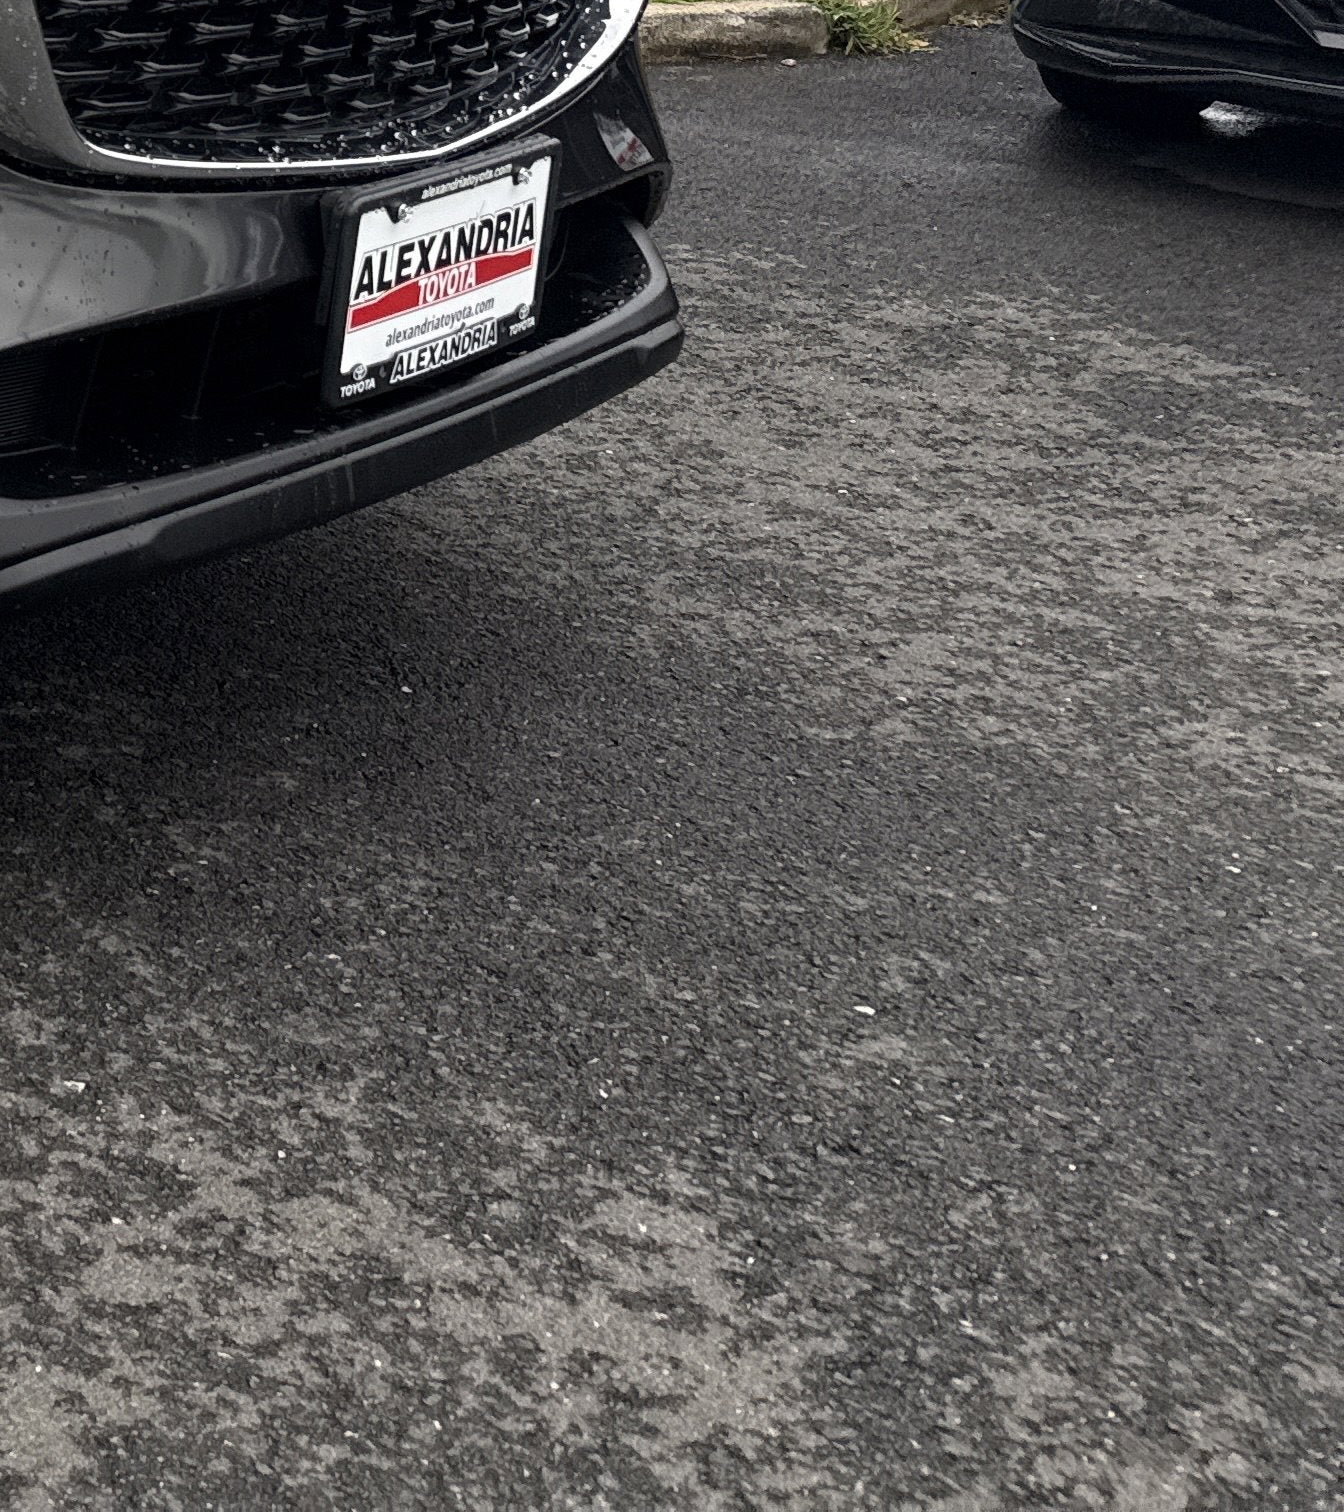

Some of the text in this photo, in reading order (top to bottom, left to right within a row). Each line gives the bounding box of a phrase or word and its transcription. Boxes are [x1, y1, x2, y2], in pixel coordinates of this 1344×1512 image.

[352, 201, 535, 301] ALEXANDRIA
[417, 261, 477, 306] TOYOTA
[385, 297, 495, 347] alexandriatoyota.com
[509, 316, 535, 336] TOYOTA
[390, 318, 498, 383] ALEXANDRIA
[340, 378, 376, 398] TOYOTA
